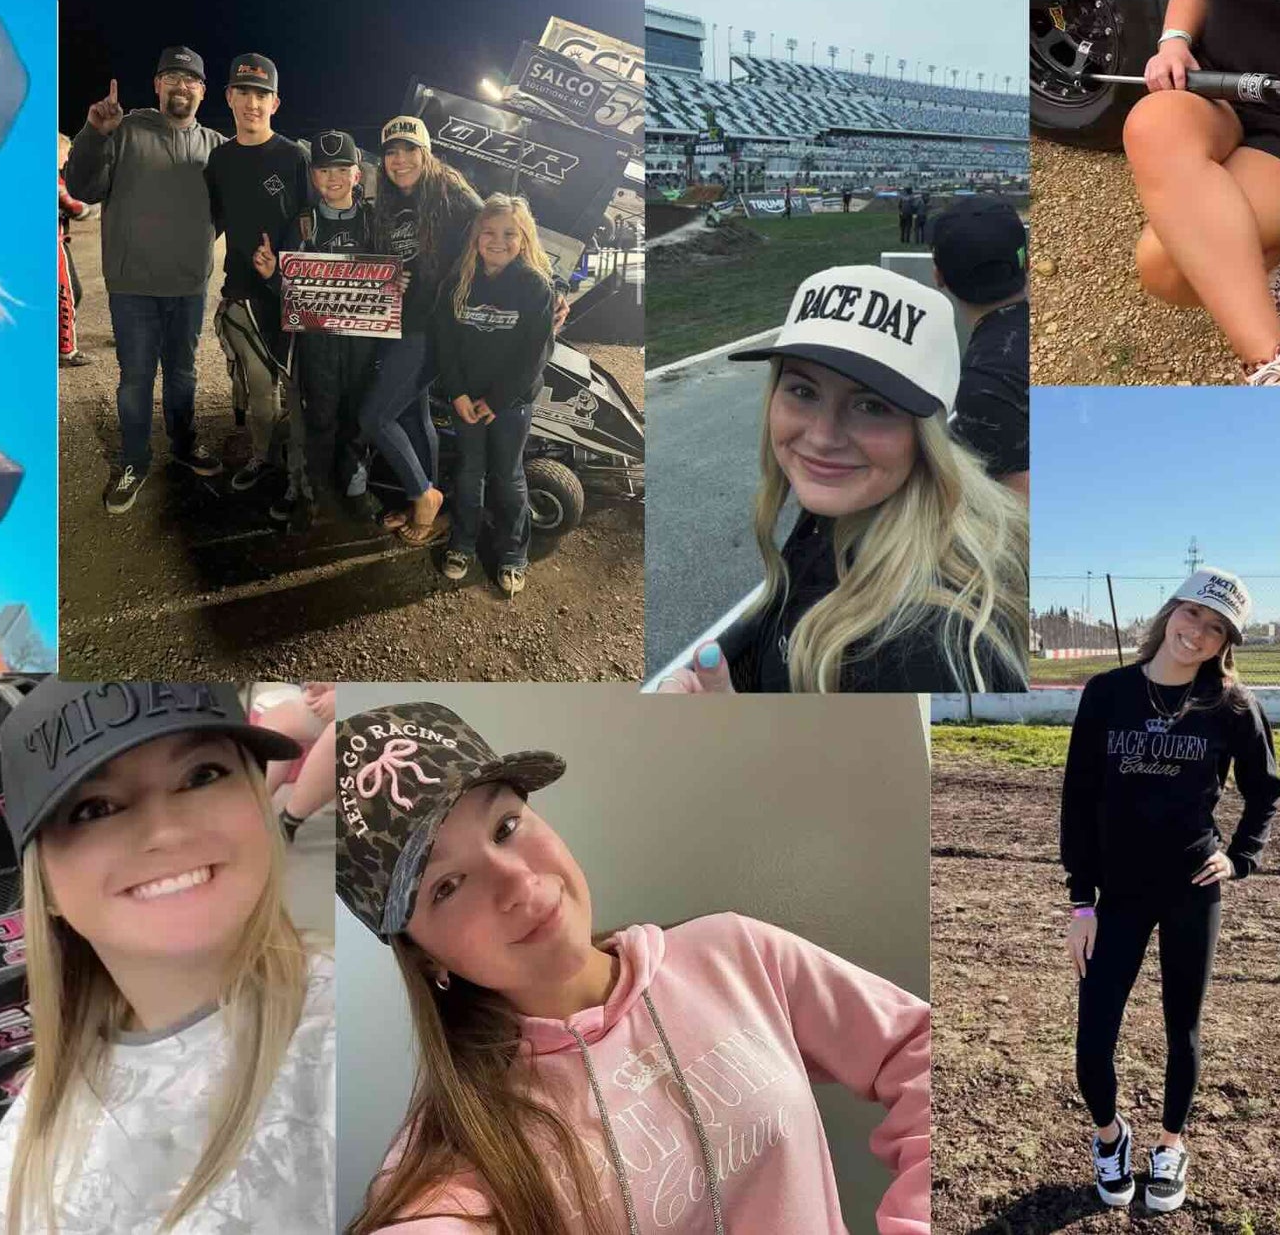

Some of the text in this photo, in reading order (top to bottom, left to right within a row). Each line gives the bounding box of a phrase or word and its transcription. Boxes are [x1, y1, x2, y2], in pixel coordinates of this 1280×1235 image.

[530, 63, 595, 96] SALCO
[283, 261, 396, 280] CYCLELAND
[292, 278, 386, 288] SPEEDWAY
[284, 289, 398, 303] FEATURE
[293, 301, 392, 316] WINNER
[794, 284, 926, 345] RACE DAY
[1106, 729, 1209, 761] RACE QUEEN
[1119, 755, 1181, 776] Couture
[340, 723, 458, 838] LET'S GO RACING
